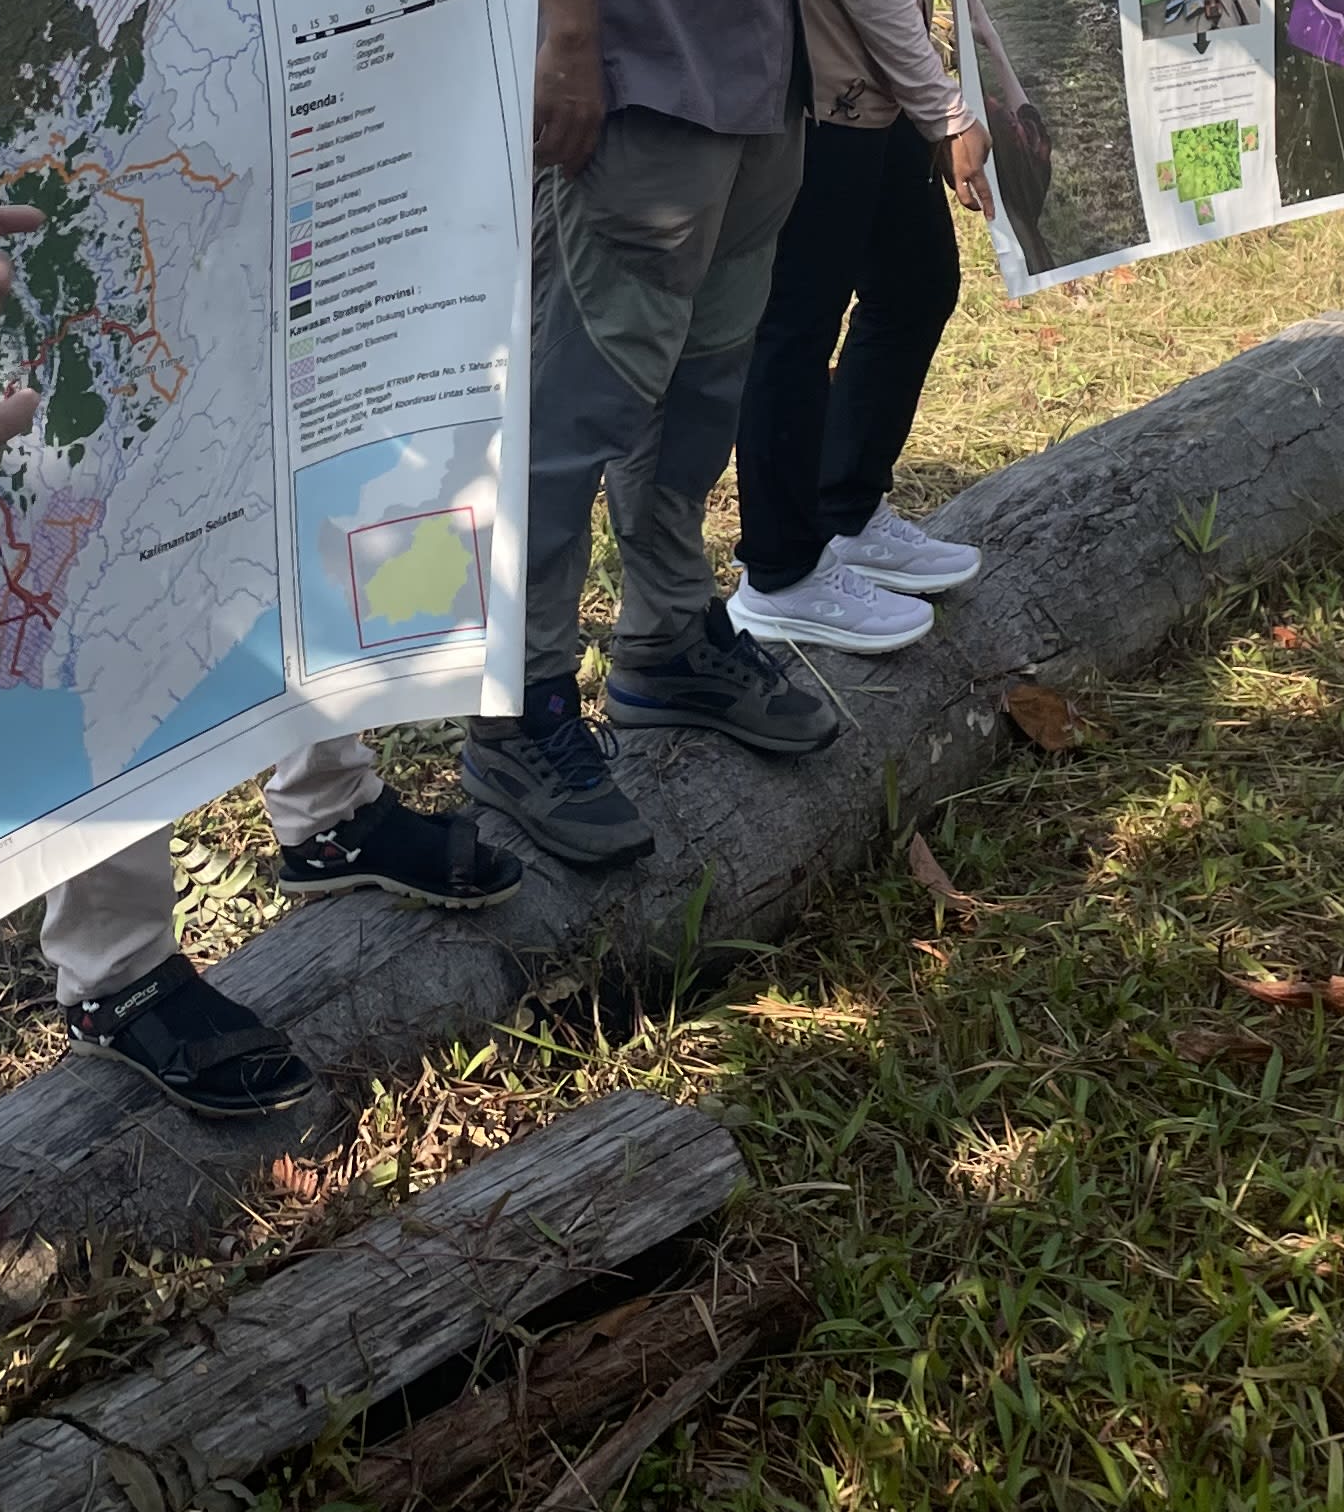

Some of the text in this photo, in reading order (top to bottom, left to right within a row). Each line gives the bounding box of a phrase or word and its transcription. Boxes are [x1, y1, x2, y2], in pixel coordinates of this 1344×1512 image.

[292, 23, 298, 34] 0
[310, 18, 320, 30] 15
[328, 14, 339, 25] 30
[365, 4, 375, 15] 60
[290, 94, 337, 117] Legenda
[290, 317, 331, 338] Kawasan
[333, 300, 372, 321] Strategis
[375, 285, 414, 306] Provinsi
[407, 297, 457, 315] Lingkungan
[459, 293, 486, 305] Hidup
[139, 506, 246, 561] Kalimantan Selatan
[114, 982, 158, 1015] GoPro
